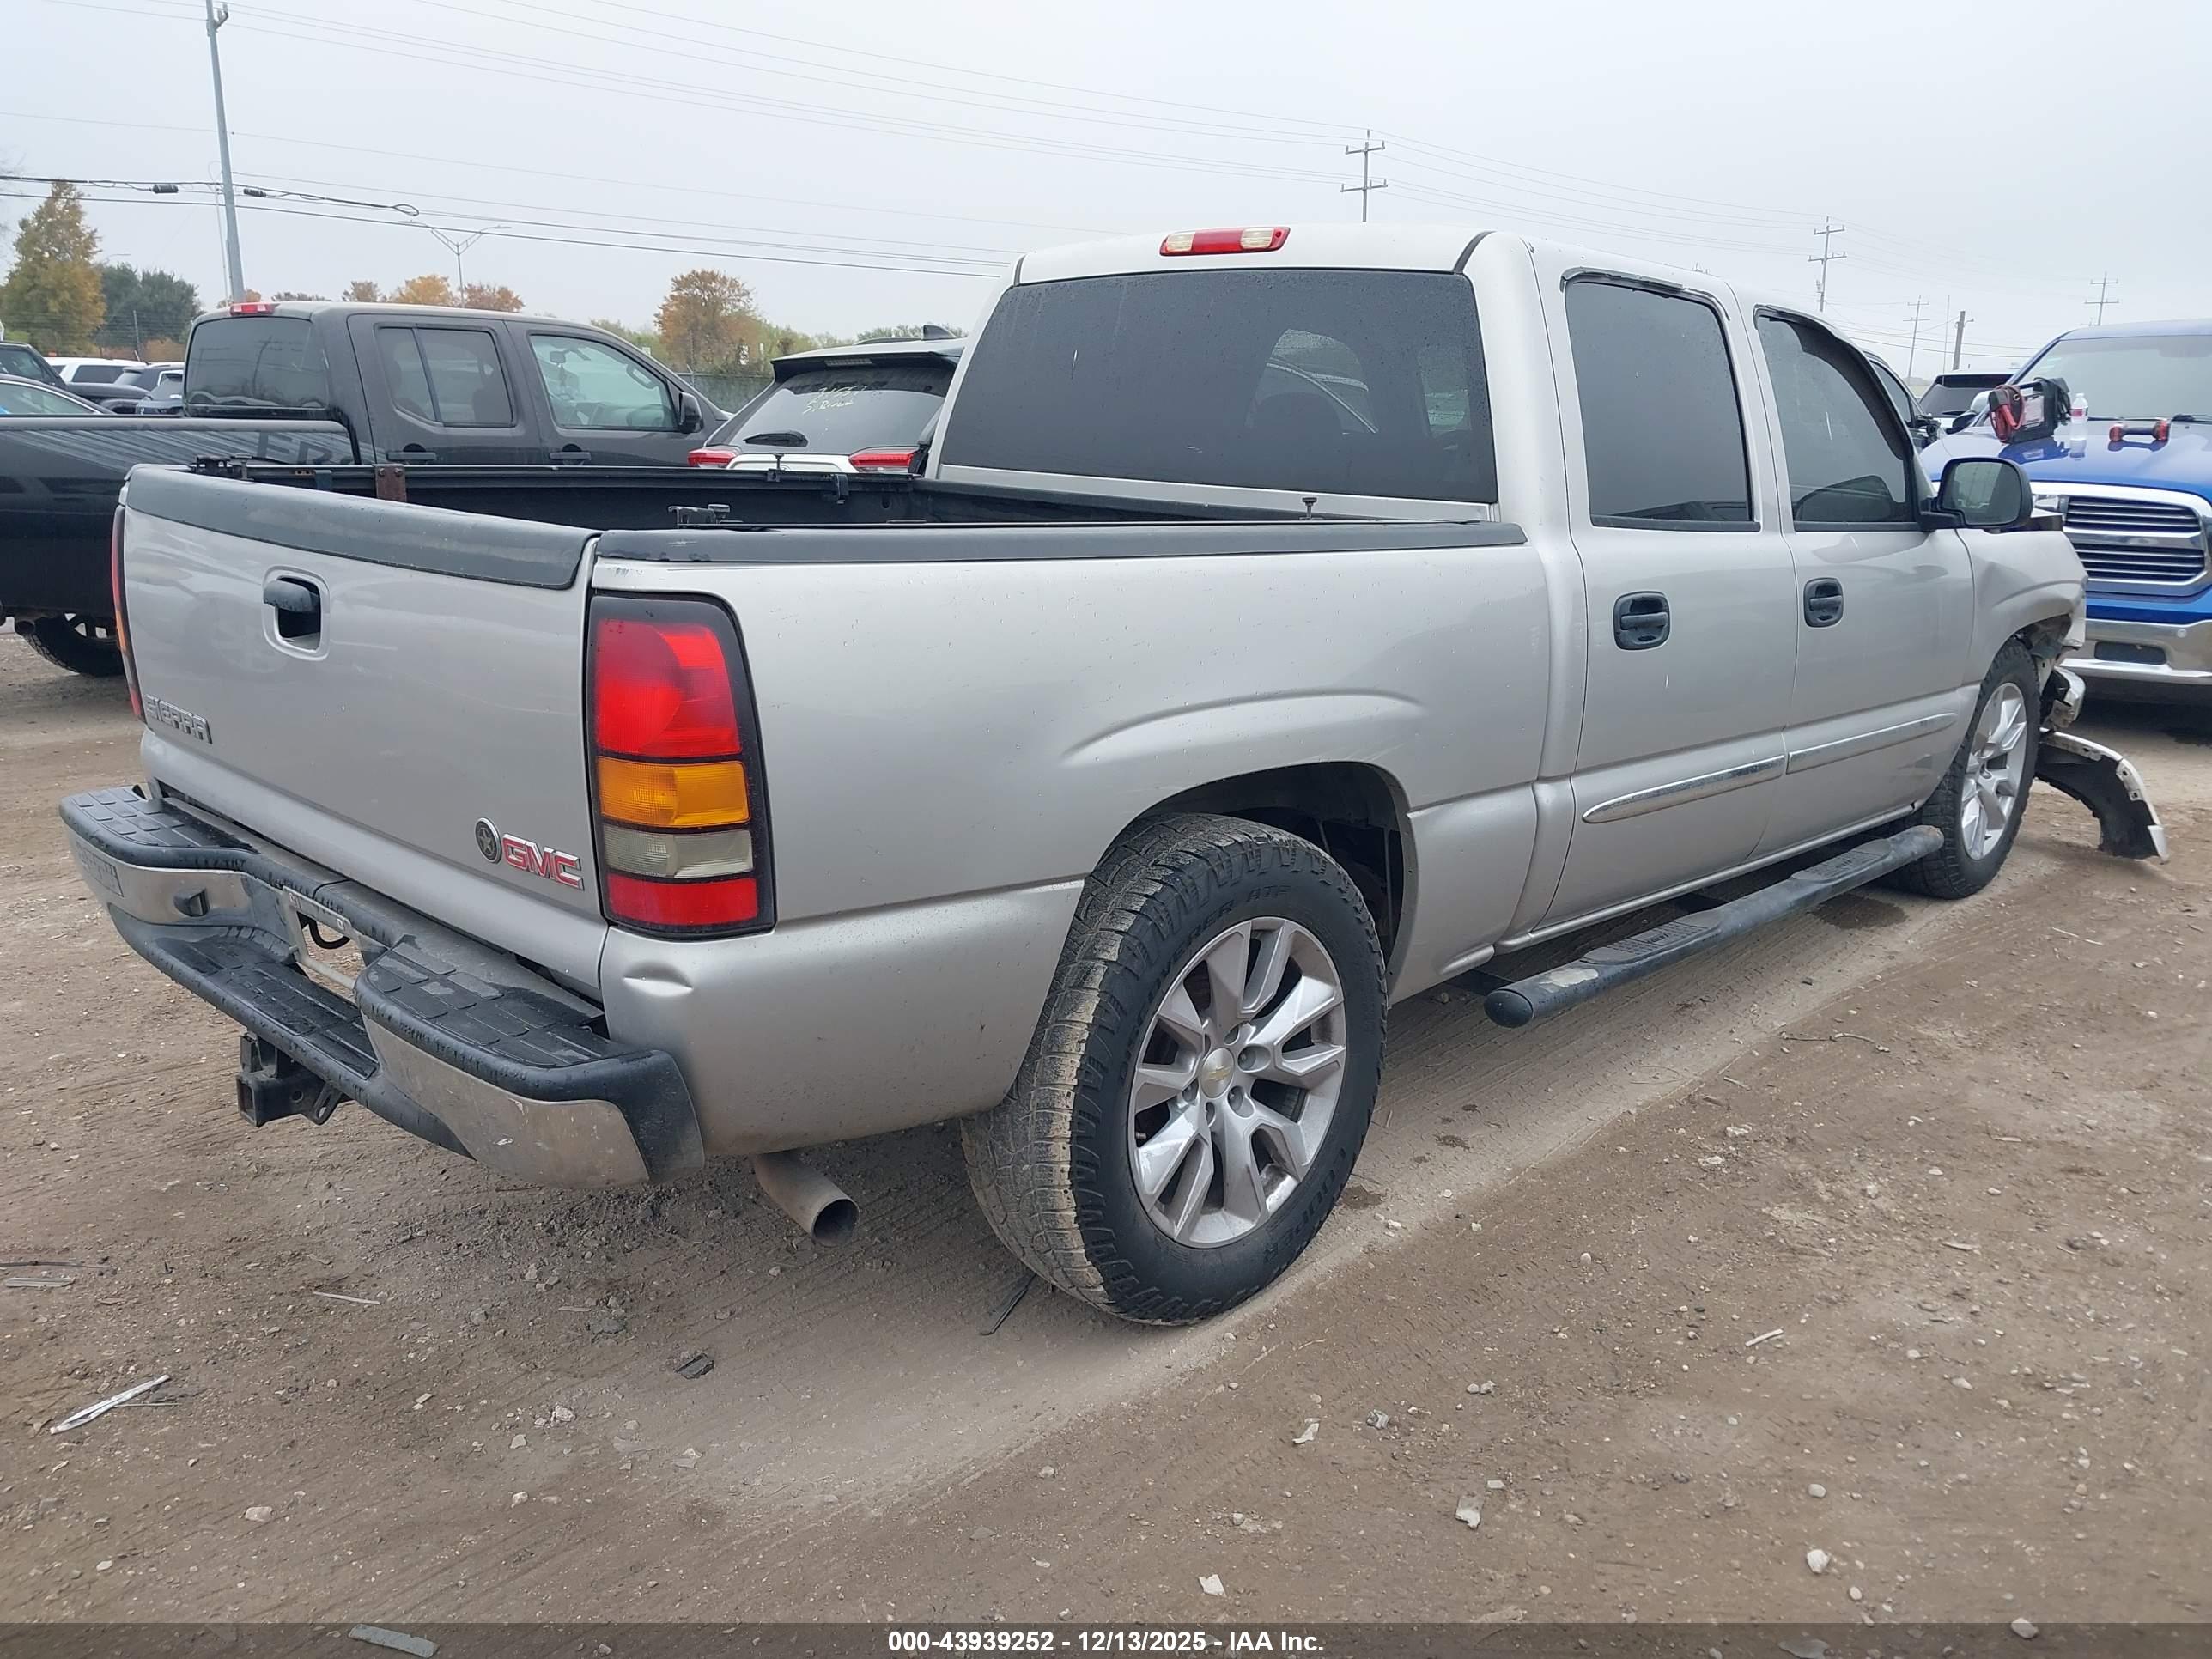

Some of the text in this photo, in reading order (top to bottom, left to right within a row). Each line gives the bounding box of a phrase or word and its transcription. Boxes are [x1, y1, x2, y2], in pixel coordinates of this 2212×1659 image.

[144, 694, 214, 745] SIERRA
[502, 833, 586, 891] GMC
[1264, 1145, 1348, 1263] COOPER
